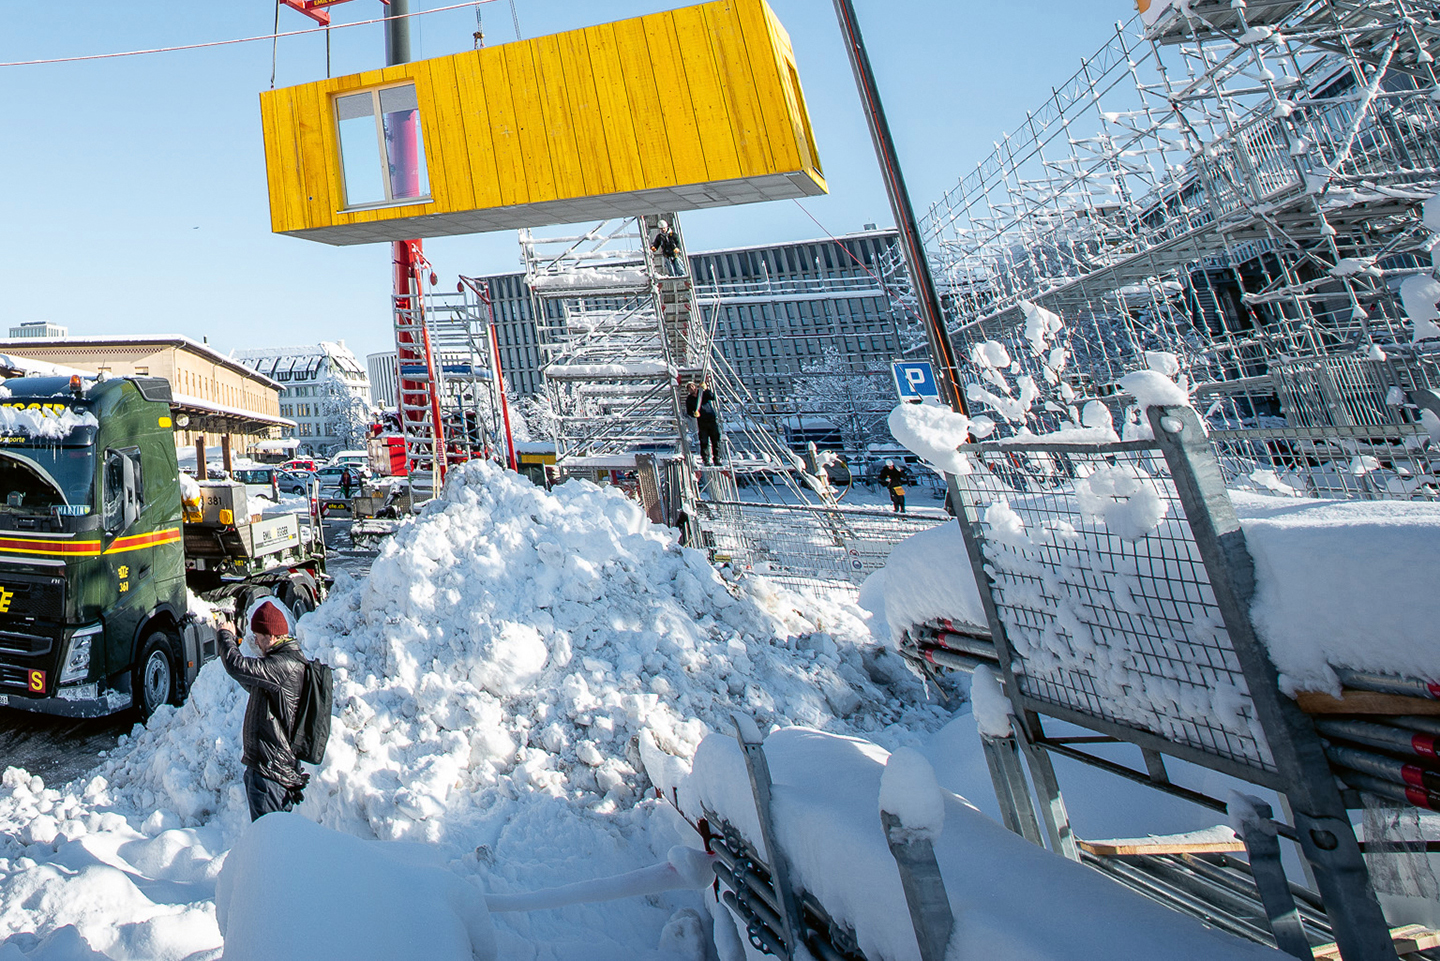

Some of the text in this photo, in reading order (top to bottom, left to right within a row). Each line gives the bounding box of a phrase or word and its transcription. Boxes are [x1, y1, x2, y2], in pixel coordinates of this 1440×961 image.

[905, 368, 925, 392] P
[208, 497, 221, 505] 381
[119, 581, 129, 592] 361
[31, 671, 43, 691] S
